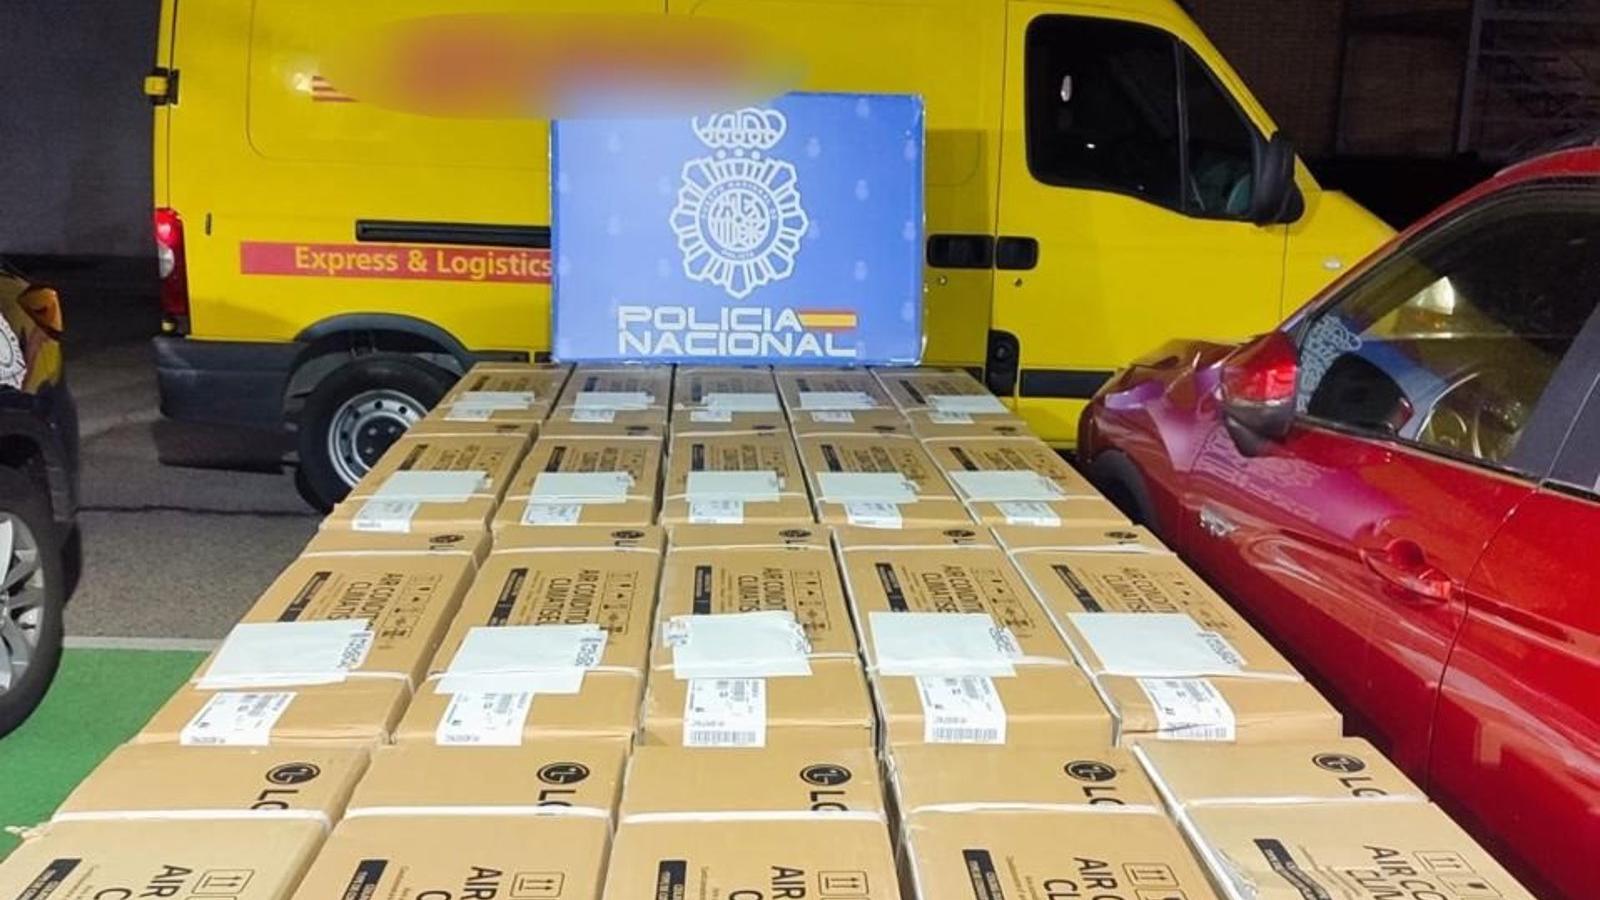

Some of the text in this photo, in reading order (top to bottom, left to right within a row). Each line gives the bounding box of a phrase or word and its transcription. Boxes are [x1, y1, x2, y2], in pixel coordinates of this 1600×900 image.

[295, 246, 552, 279] Express & Logistics
[618, 306, 802, 332] POLICIA
[618, 331, 857, 357] NACIONAL
[1073, 857, 1118, 889] AIR
[1363, 845, 1417, 876] AIR
[139, 864, 192, 899] AIR
[460, 866, 503, 900] AIR
[771, 866, 806, 900] AIR
